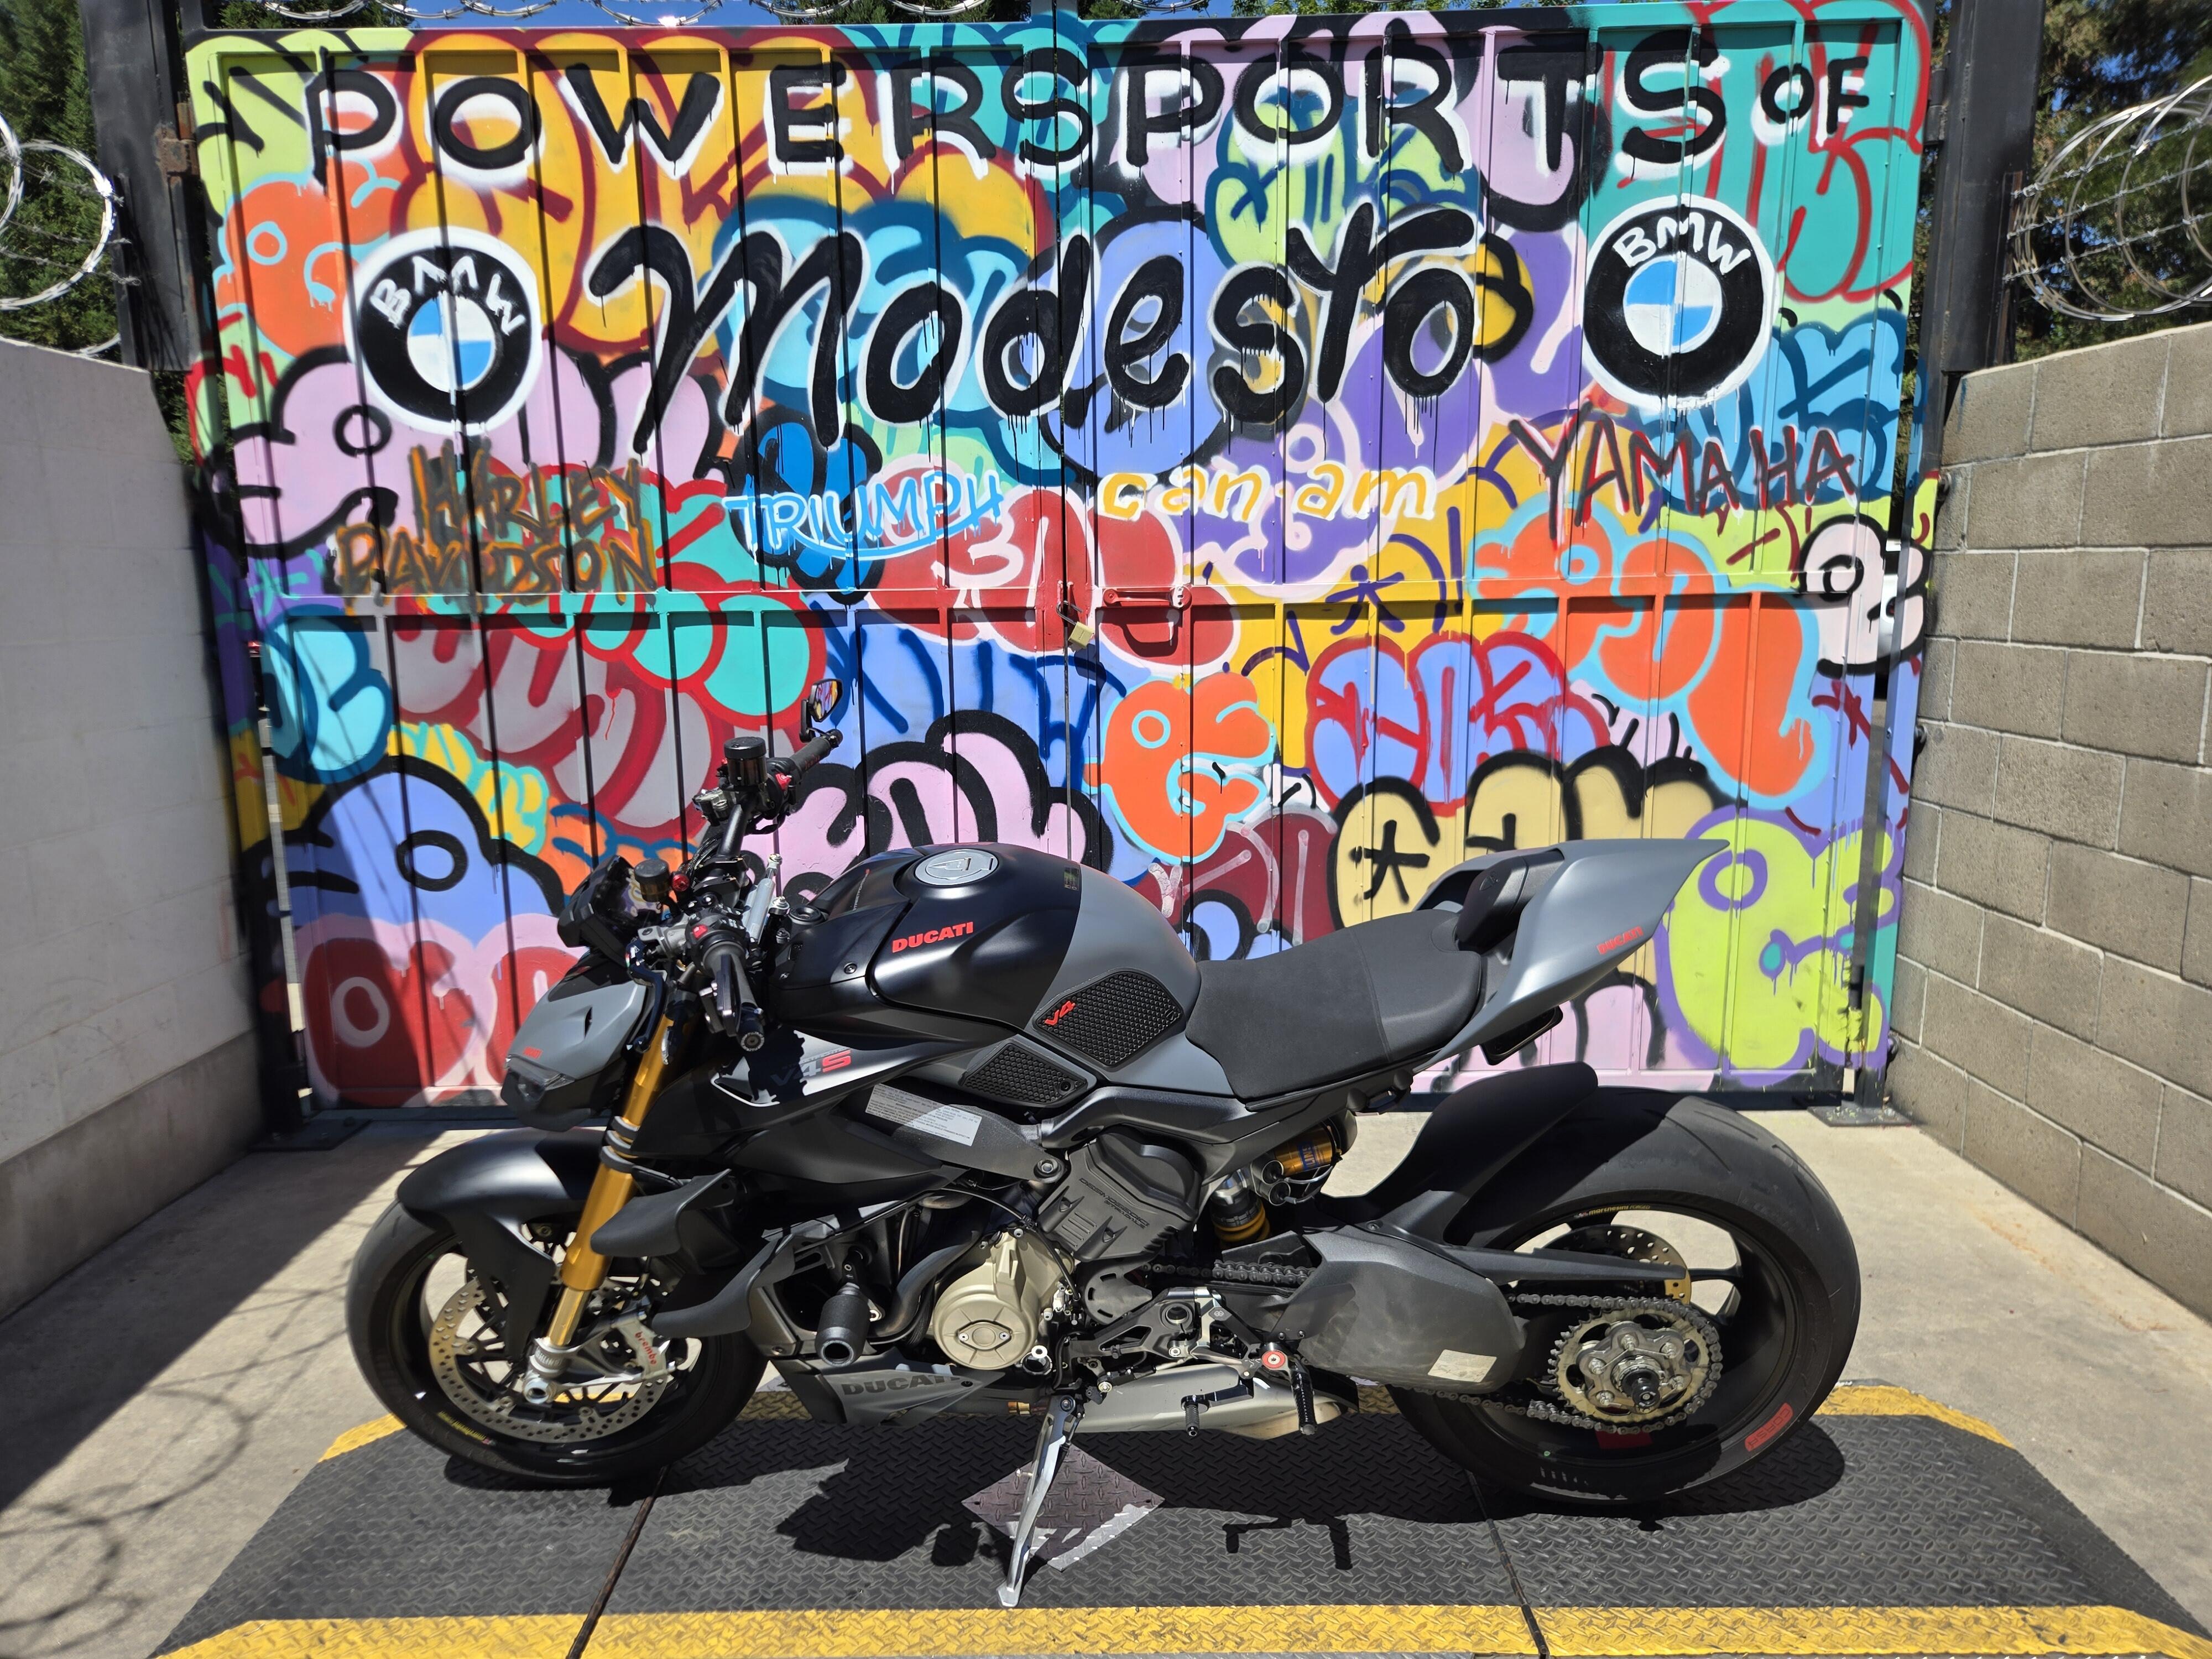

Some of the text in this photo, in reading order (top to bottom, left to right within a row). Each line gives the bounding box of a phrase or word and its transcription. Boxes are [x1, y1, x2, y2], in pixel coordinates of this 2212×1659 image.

[304, 17, 1870, 188] POWERSPORTS OF
[1611, 211, 1752, 276] BMW
[369, 254, 526, 336] BMW
[1508, 401, 1858, 550] YAMAHA
[721, 470, 1004, 559] TRIUMPH
[891, 921, 974, 954] DUCATI
[1596, 925, 1644, 956] DUCATI
[1044, 1000, 1076, 1026] V4
[634, 1331, 657, 1365] brembo
[1747, 1407, 1791, 1448] CORSA
